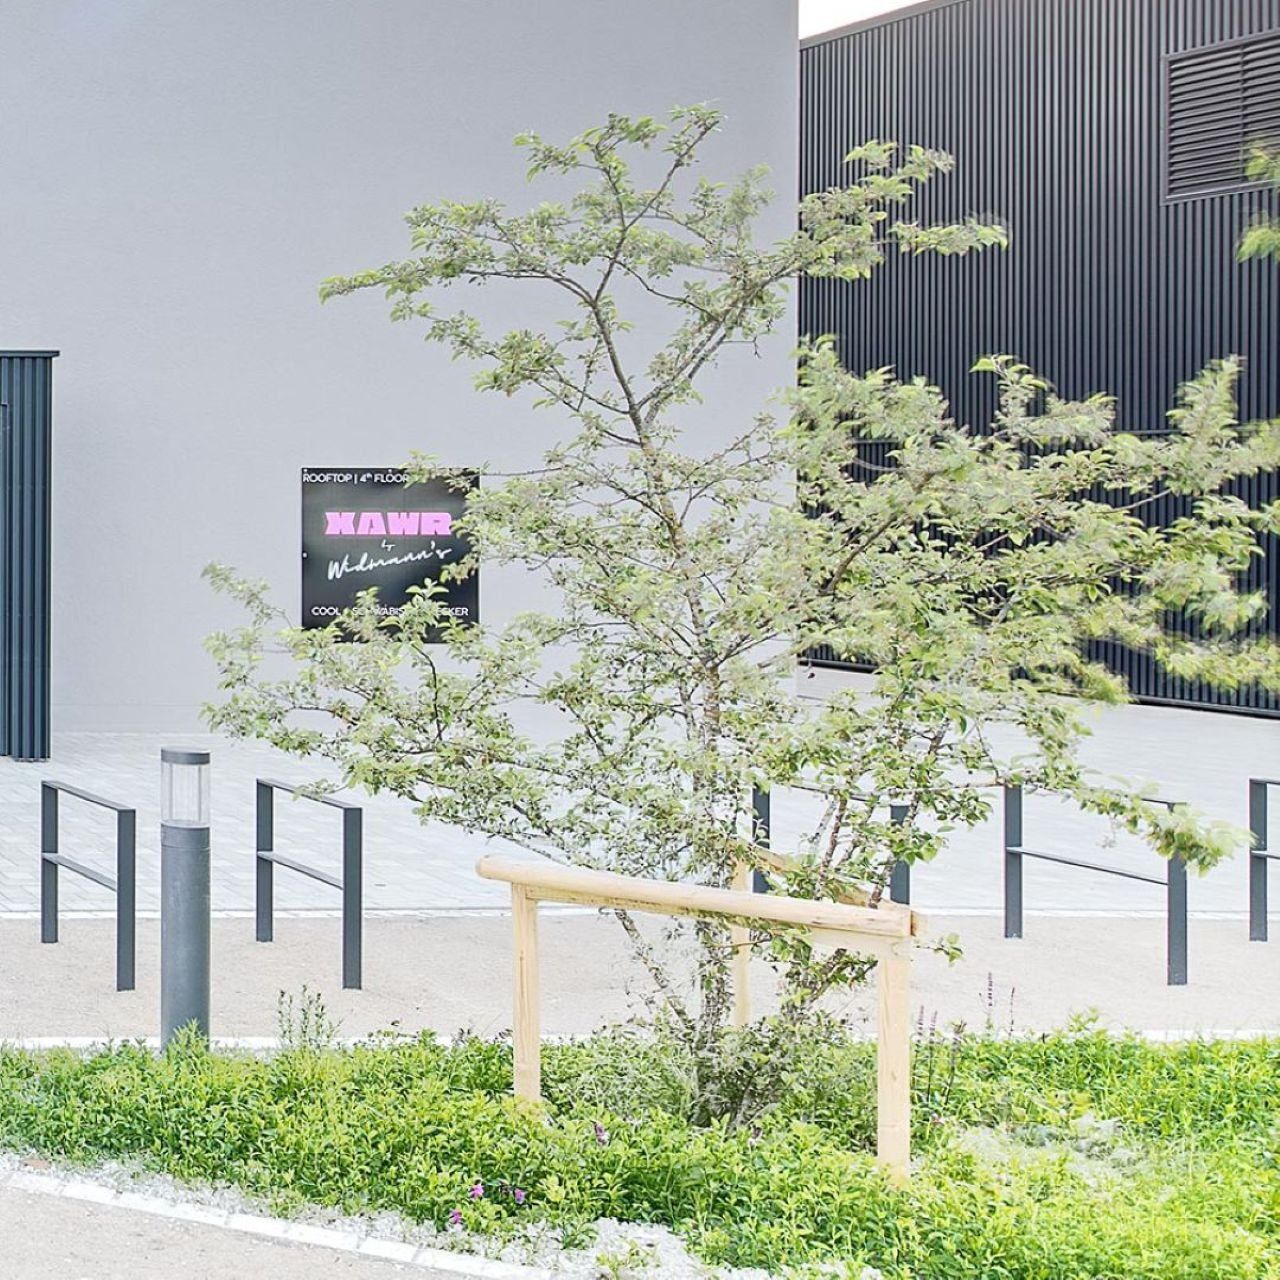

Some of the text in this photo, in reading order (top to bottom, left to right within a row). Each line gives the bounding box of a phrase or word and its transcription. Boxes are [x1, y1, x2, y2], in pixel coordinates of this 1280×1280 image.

[302, 473, 353, 483] ROOFTOP
[373, 473, 409, 483] FLOOR
[324, 511, 452, 535] XAWR
[327, 539, 453, 581] Widmann's
[311, 606, 341, 616] COOL
[436, 607, 469, 616] EKER
